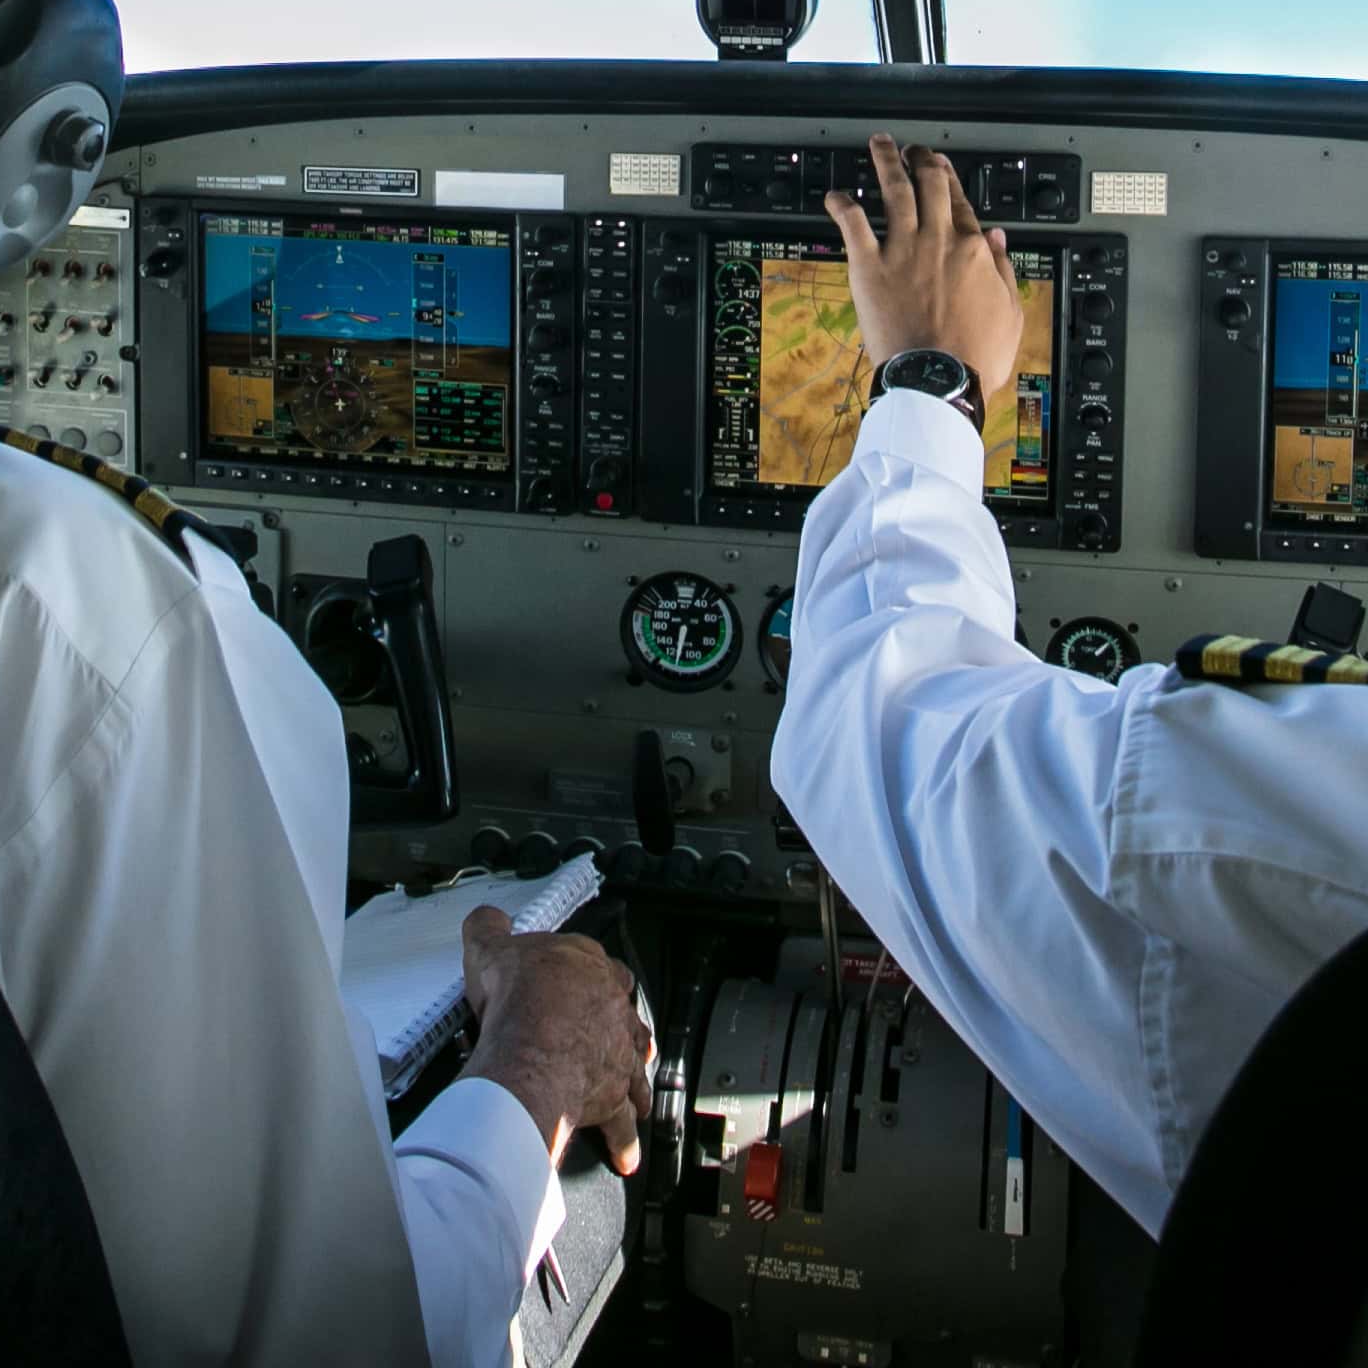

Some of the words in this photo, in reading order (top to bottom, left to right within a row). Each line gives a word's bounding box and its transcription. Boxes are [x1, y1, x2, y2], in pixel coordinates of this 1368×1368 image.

[1082, 394, 1107, 402] RANGE
[658, 600, 677, 609] 200
[694, 599, 708, 608] 40
[654, 611, 670, 619] 180
[652, 622, 668, 630] 160
[657, 636, 673, 645] 140
[685, 650, 702, 660] 100
